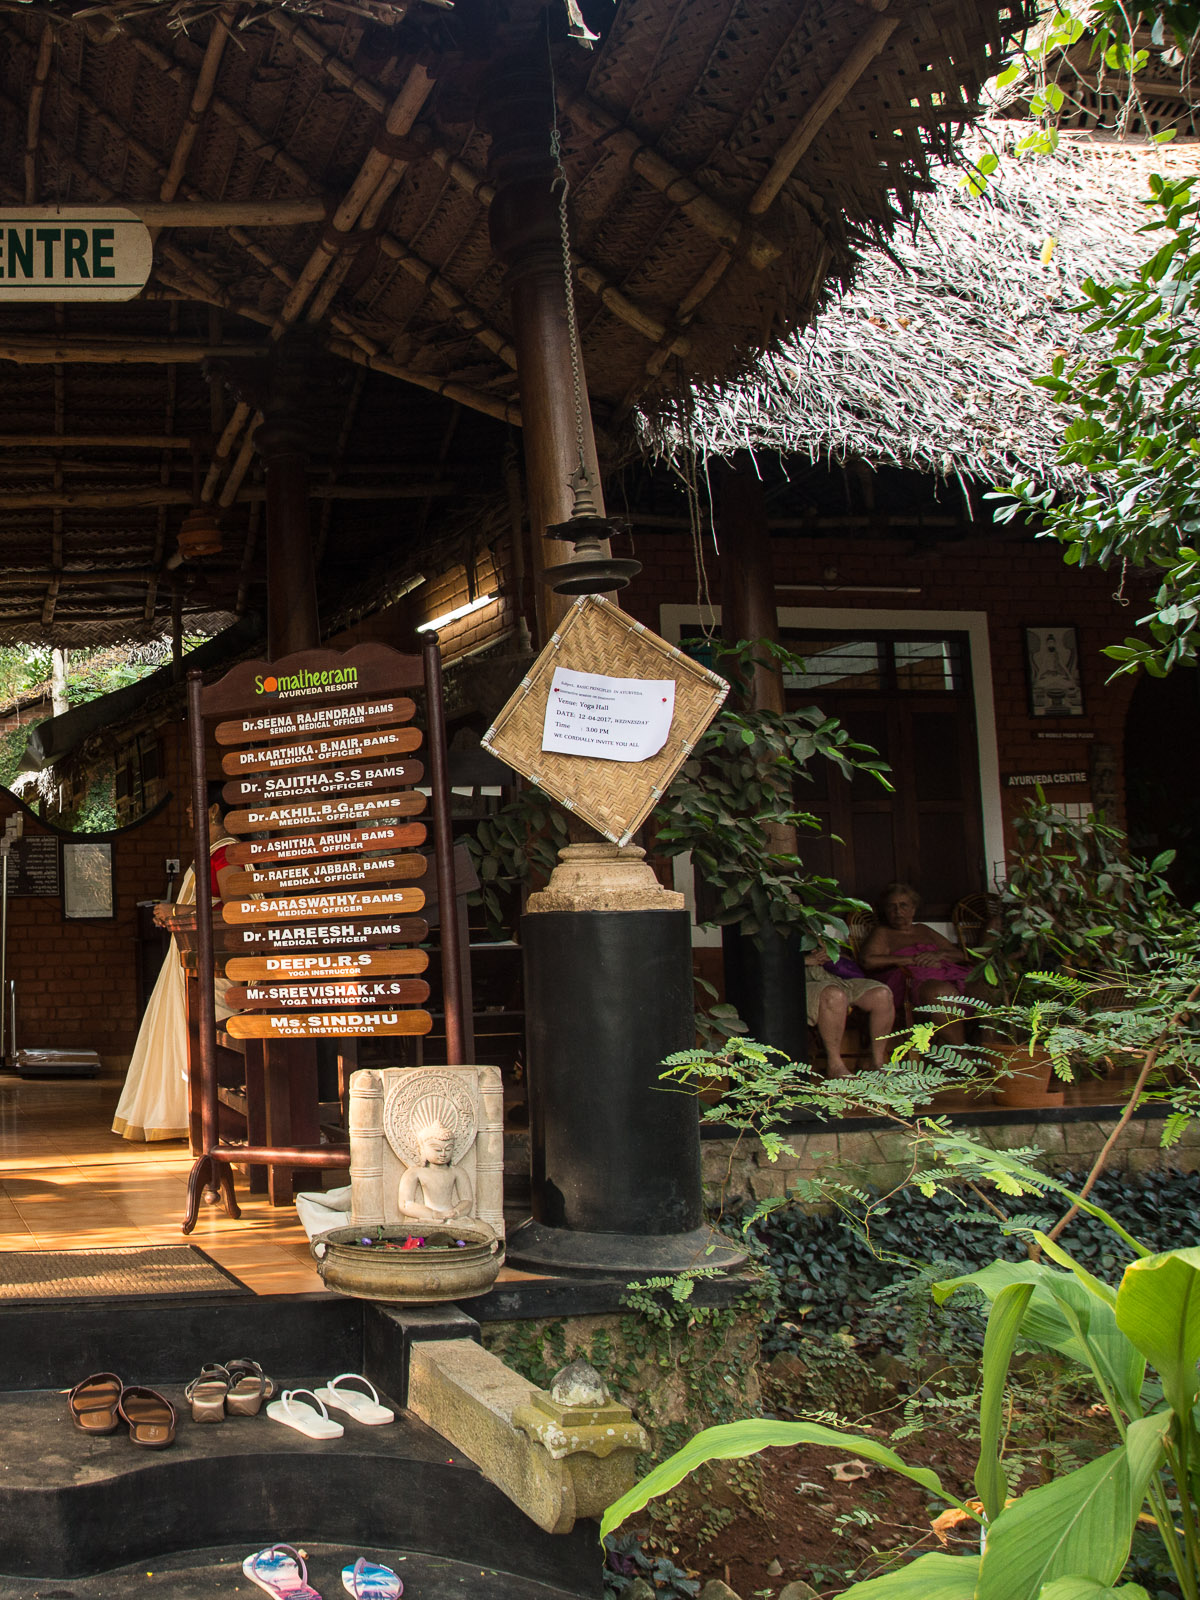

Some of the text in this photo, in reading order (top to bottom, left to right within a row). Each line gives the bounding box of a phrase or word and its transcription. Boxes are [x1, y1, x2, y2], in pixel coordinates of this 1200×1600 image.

[279, 682, 359, 698] AYURVEDA RESORT
[558, 697, 578, 706] Venue:
[580, 701, 595, 710] Yoga
[556, 709, 576, 718] DATE:
[270, 716, 365, 735] SENIOR MEDICAL OFFICER
[555, 721, 570, 729] Time
[564, 734, 594, 743] CORDIALLY
[270, 748, 363, 767] MEDICAL OFFICER
[241, 766, 405, 793] Dr. SAJITHA.S.S BAMS
[1009, 772, 1087, 786] AYURVEDA CENTRE
[264, 780, 373, 798] MEDICAL OFFICER
[278, 810, 370, 826] MEDICAL OFFICER
[361, 830, 395, 841] BAMS
[278, 842, 364, 858] MEDICAL OFFICER
[314, 862, 361, 876] JABBAR,
[363, 859, 395, 870] BAMS
[280, 872, 366, 888] MEDICAL OFFICER
[277, 905, 363, 917] MEDICAL OFFICER
[273, 936, 368, 947] MEDICAL OFFICER
[266, 954, 372, 970] DEEPU.R.S
[311, 968, 361, 976] INSTRUCTOR
[312, 996, 376, 1005] INSTRUCTOR
[270, 1013, 398, 1028] Ms.SINDHU
